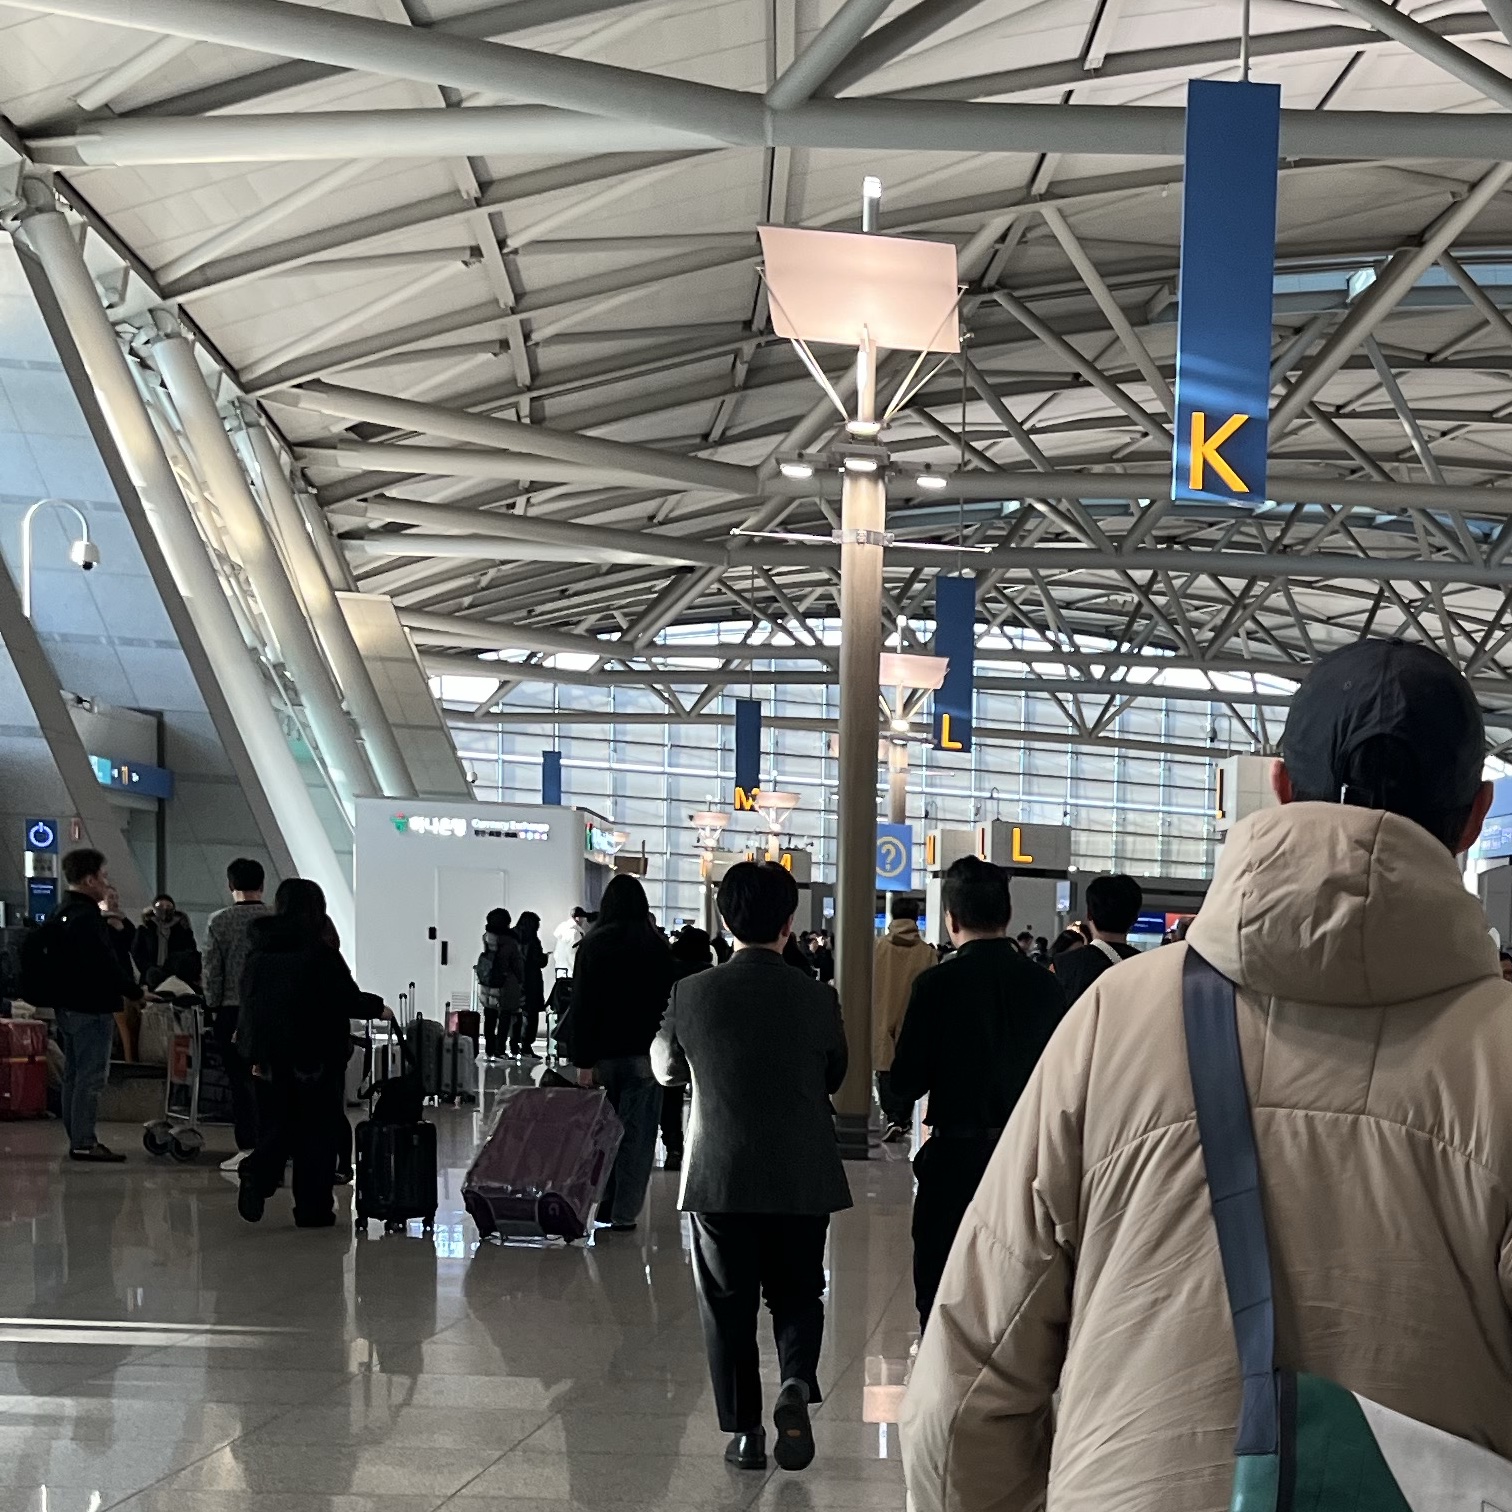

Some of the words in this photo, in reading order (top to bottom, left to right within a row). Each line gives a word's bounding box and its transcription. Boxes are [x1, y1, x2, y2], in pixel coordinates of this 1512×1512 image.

[1189, 411, 1250, 493] K
[941, 713, 963, 750] L
[1012, 827, 1033, 863] L
